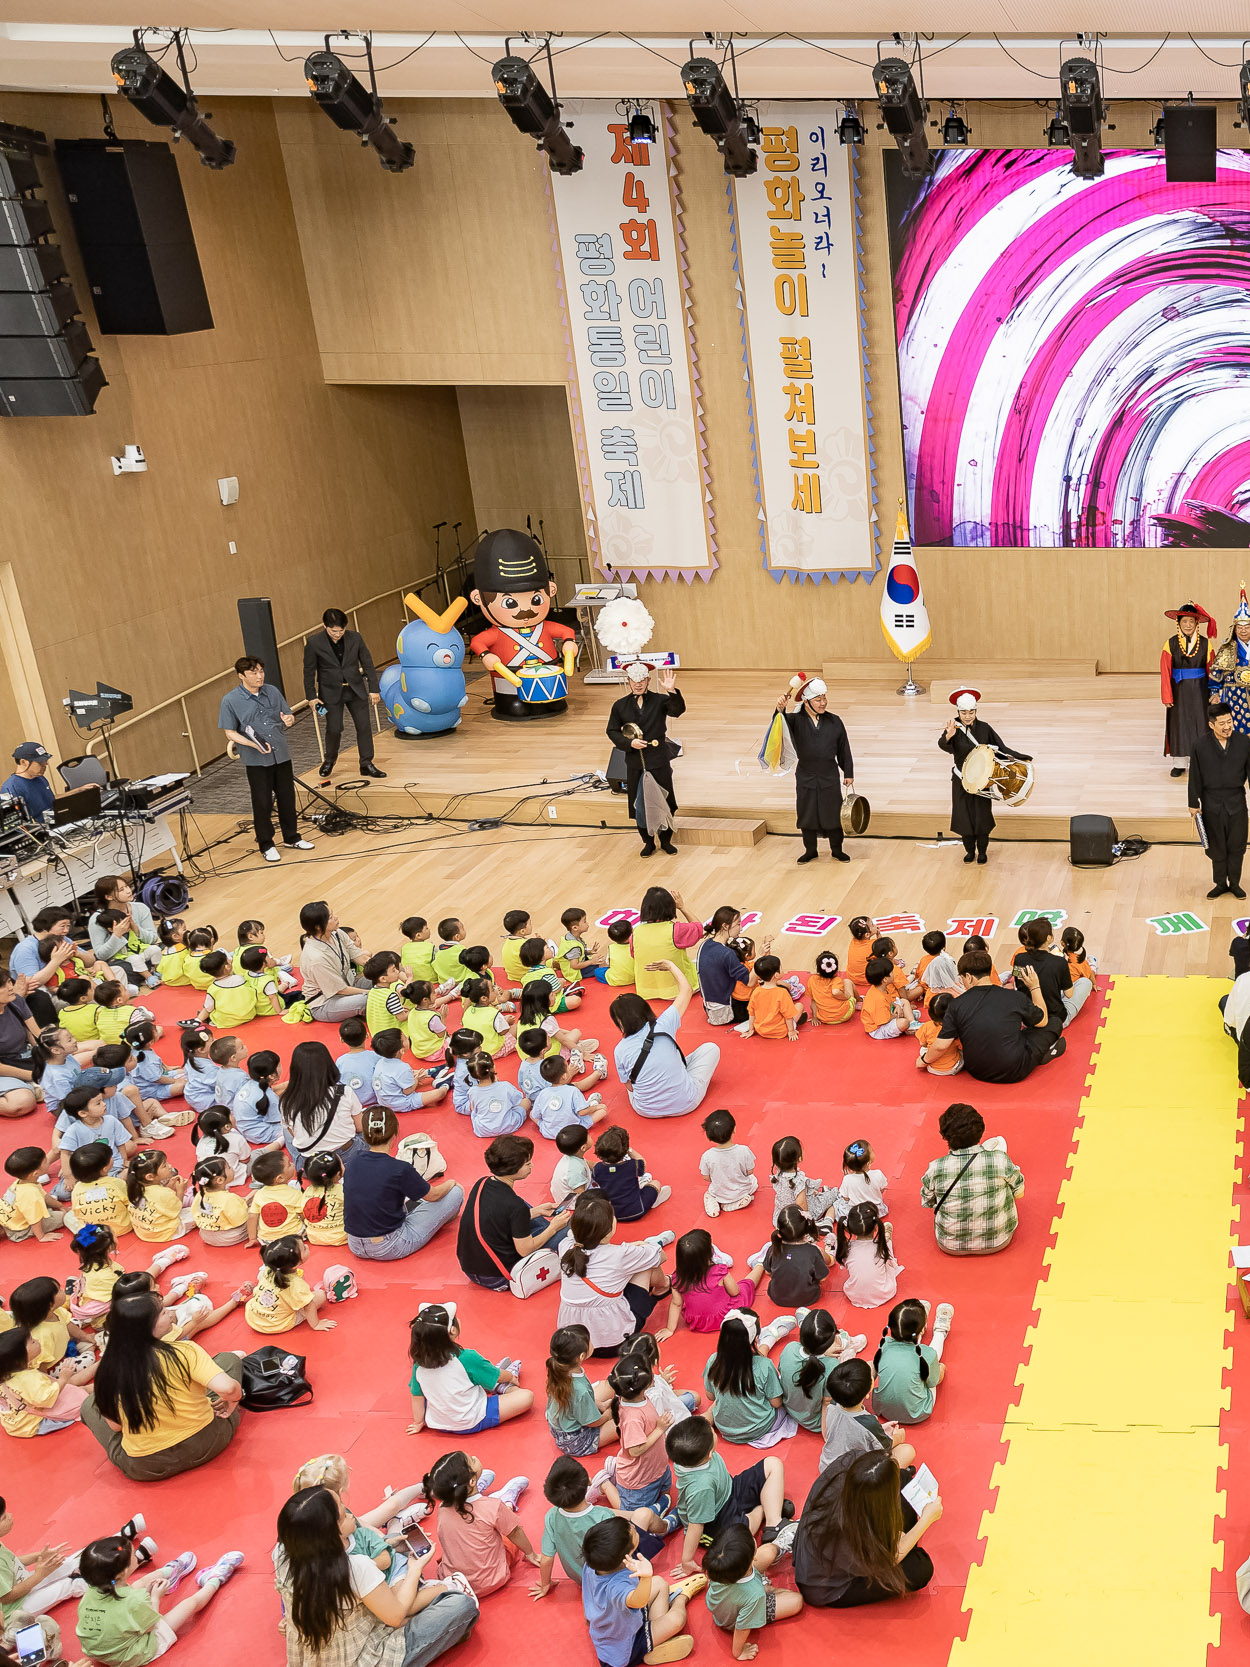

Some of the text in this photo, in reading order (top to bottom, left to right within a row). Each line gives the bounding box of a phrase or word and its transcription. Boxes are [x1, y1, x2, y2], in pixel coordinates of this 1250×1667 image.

[574, 232, 646, 510] 평화통일 축제
[628, 277, 677, 410] 어린이
[760, 125, 823, 514] 평화놀이 펼쳐보세
[80, 1204, 117, 1216] Vicky
